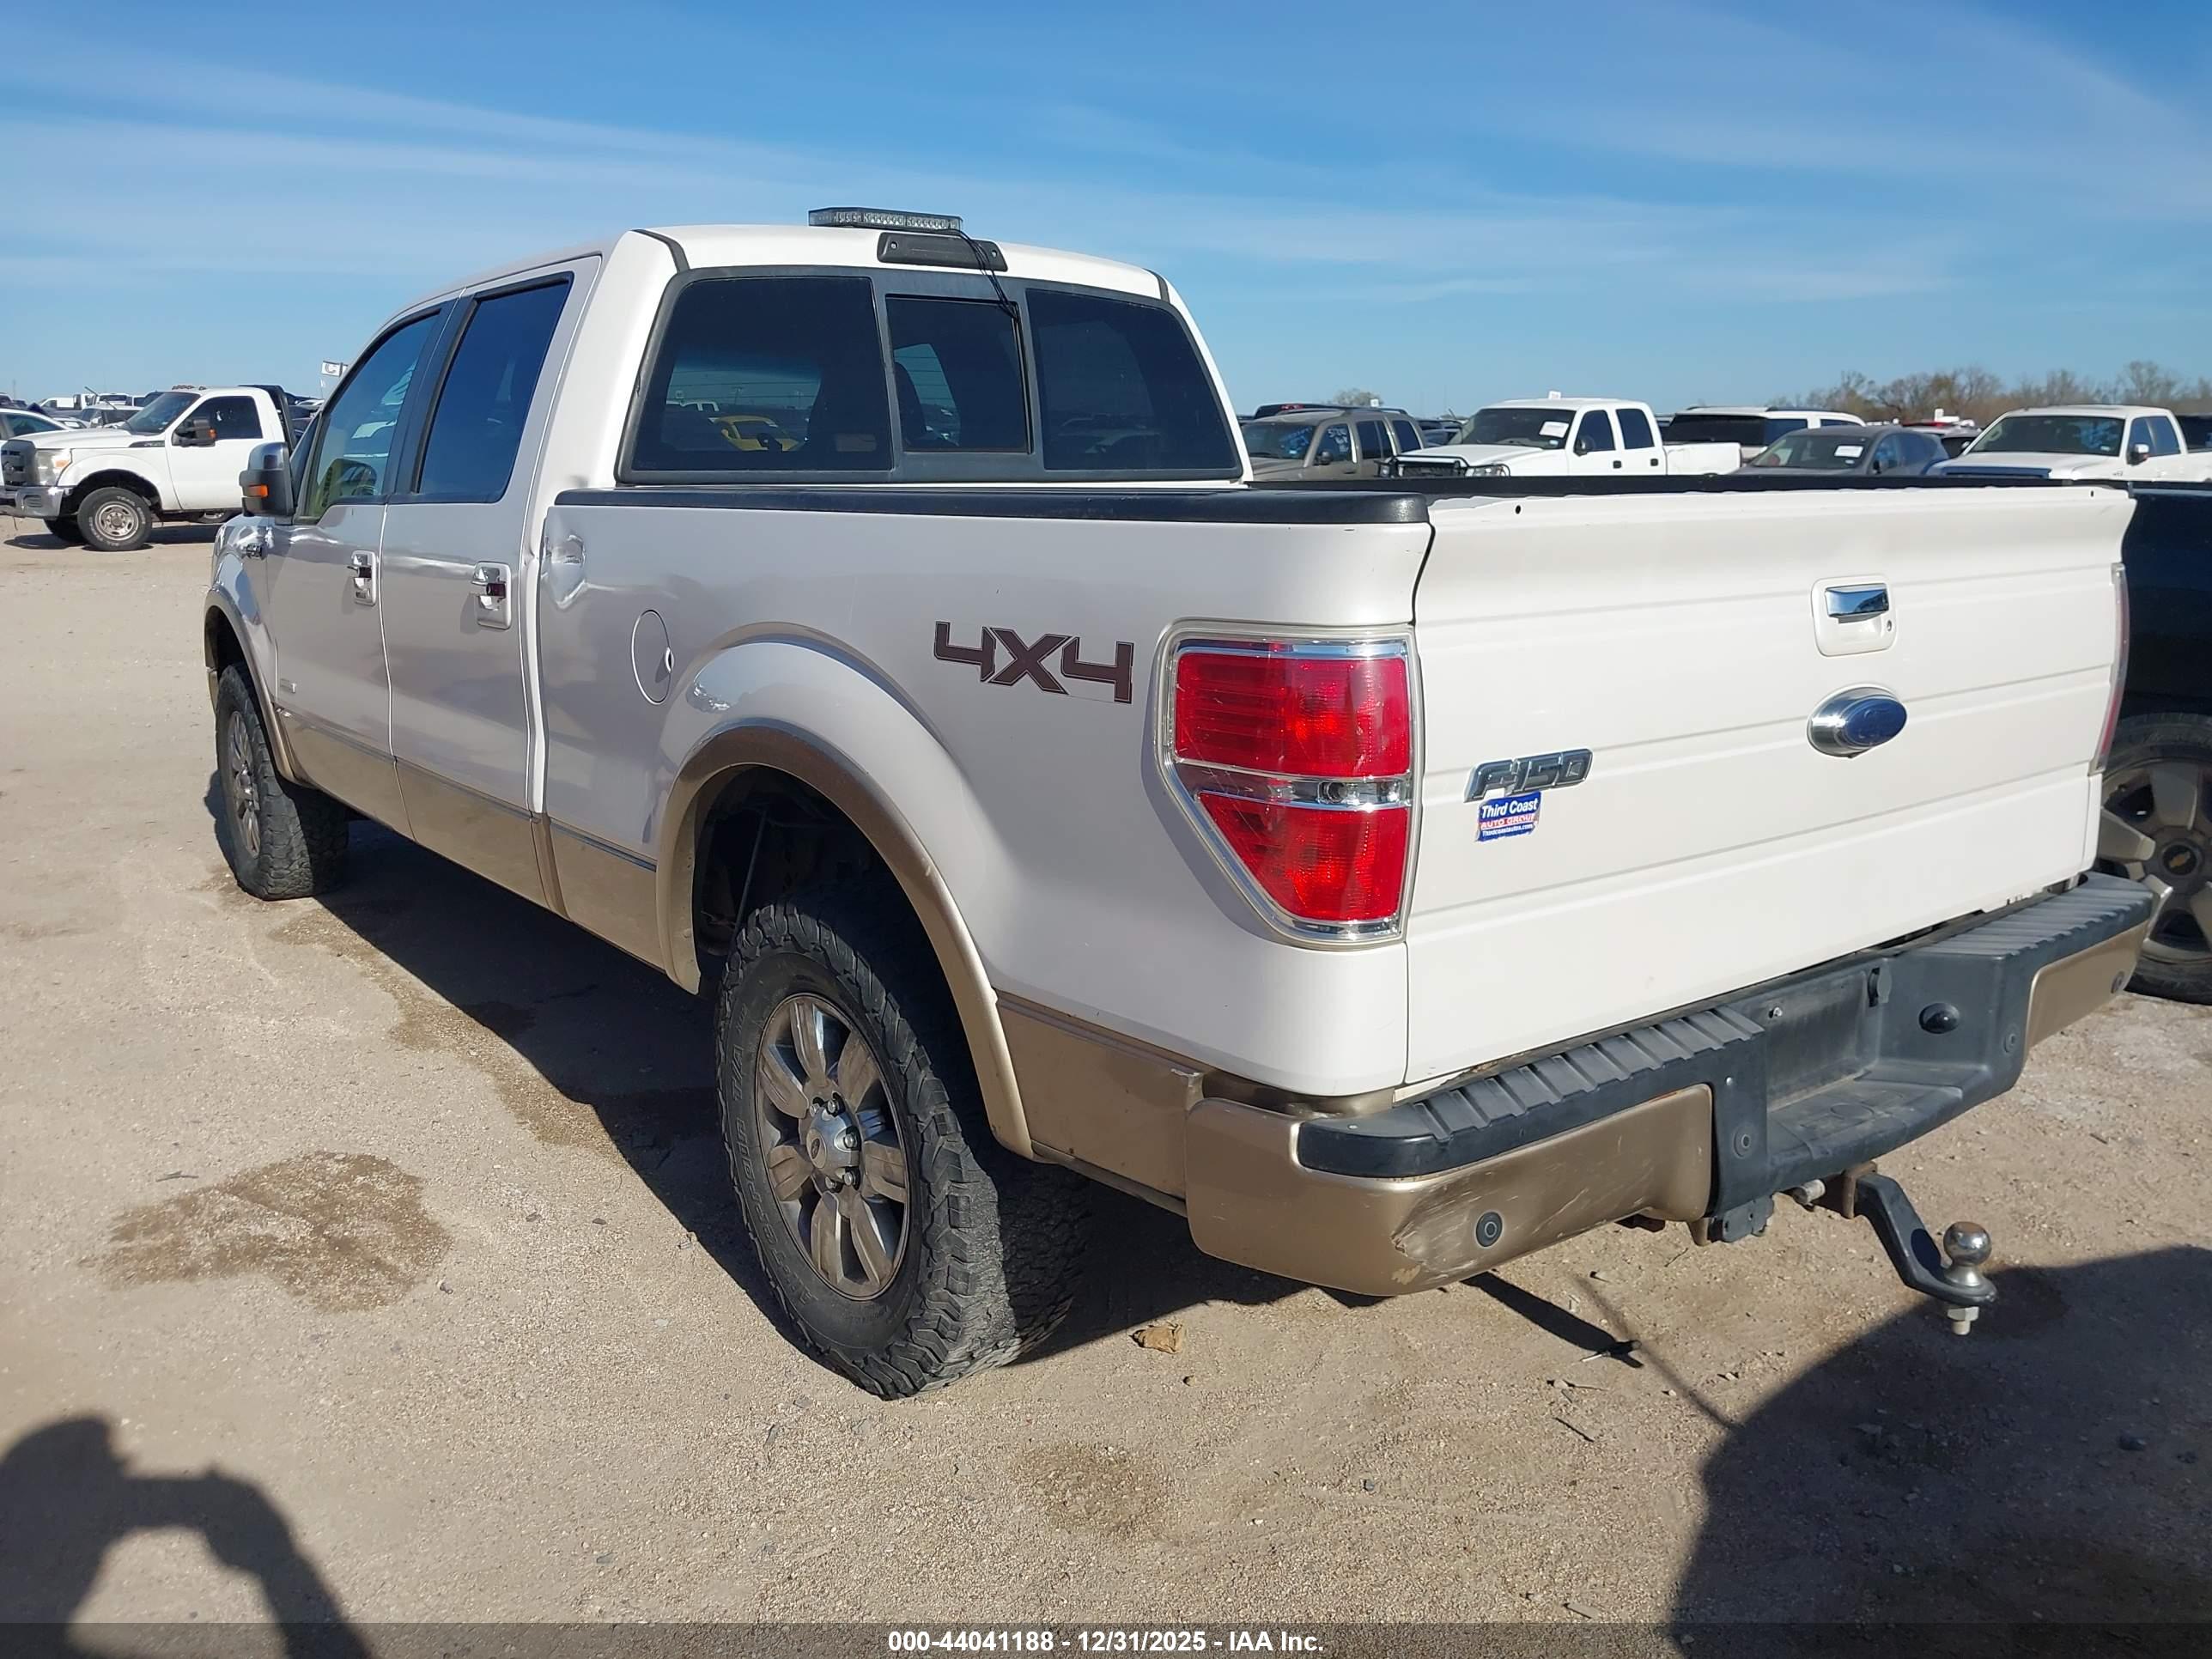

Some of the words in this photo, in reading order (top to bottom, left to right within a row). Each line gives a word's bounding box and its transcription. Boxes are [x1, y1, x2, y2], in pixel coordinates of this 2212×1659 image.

[934, 621, 1134, 704] 4X4
[1464, 748, 1594, 803] F-150
[1480, 820, 1505, 830] AUTO
[1482, 802, 1509, 819] Third
[1509, 798, 1538, 814] Coast
